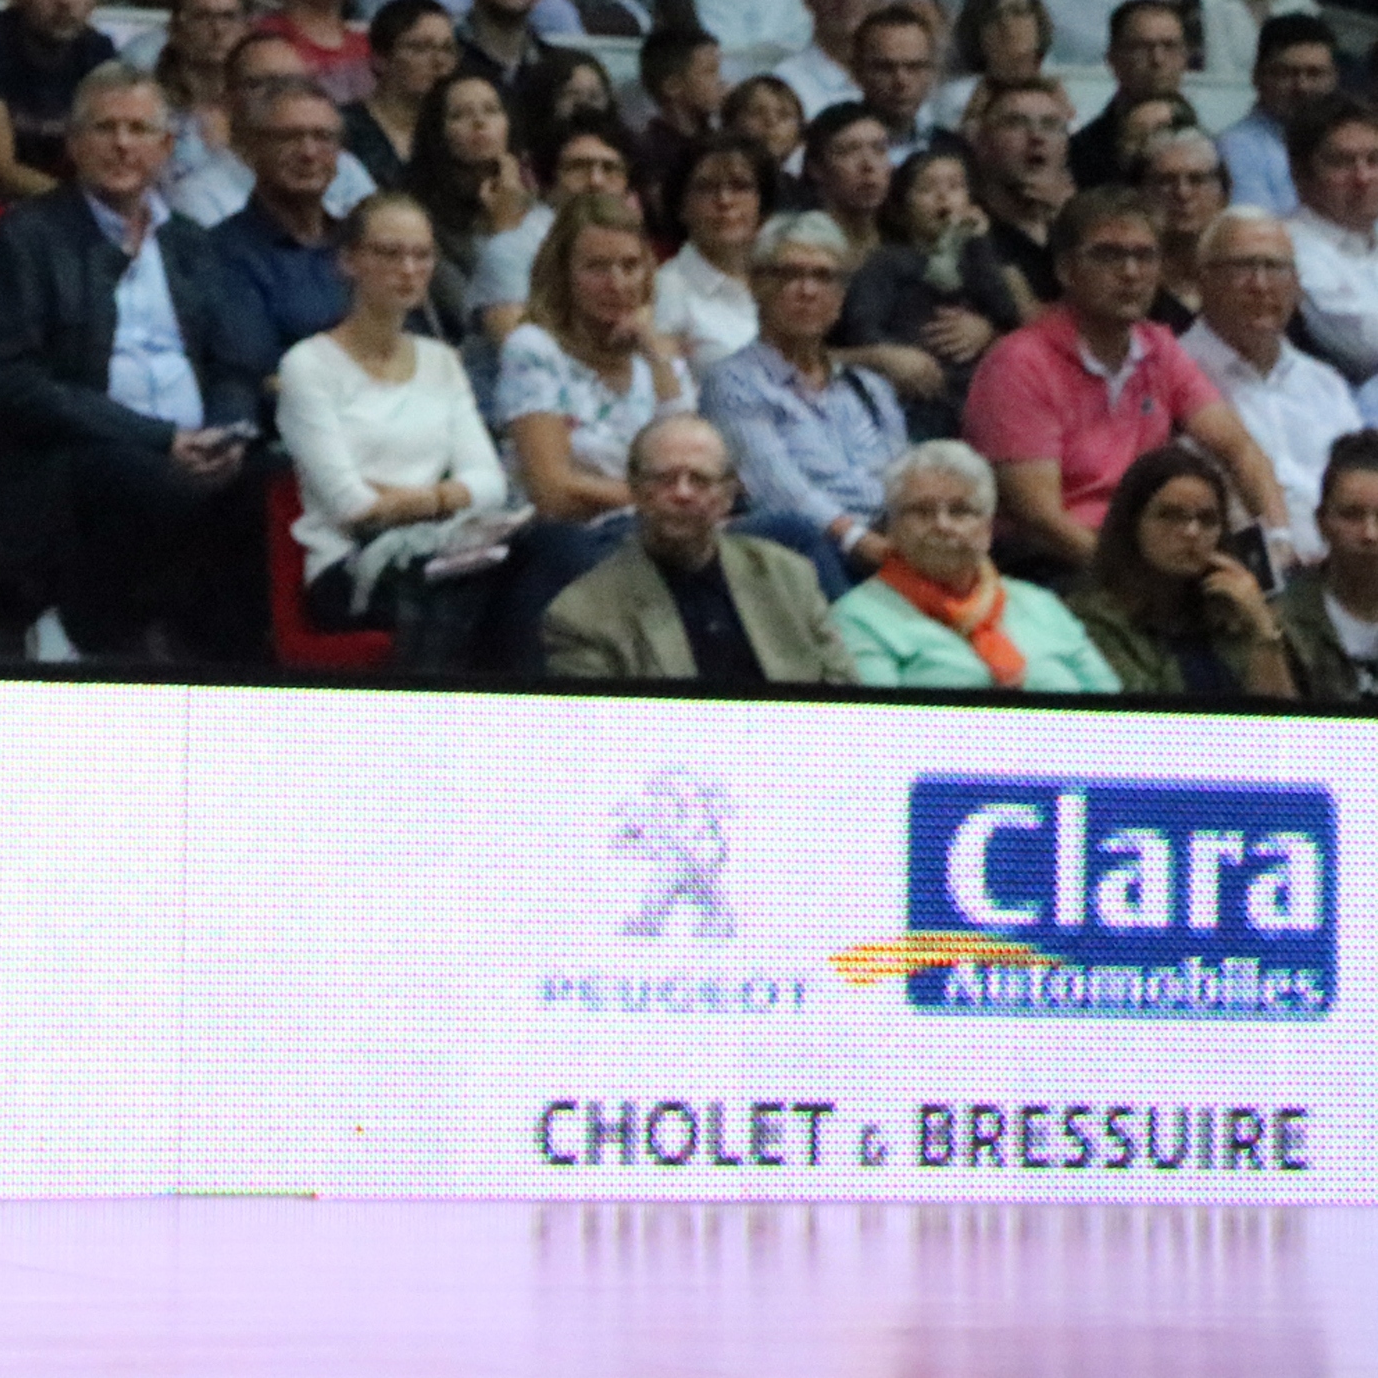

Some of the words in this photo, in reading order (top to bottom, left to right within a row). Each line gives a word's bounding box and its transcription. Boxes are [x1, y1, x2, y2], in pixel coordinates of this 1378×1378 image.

[946, 792, 1324, 930] Clara
[943, 957, 1325, 1011] Automobiles
[537, 1100, 835, 1166] CHOLET
[917, 1103, 1310, 1171] BRESSUIRE
